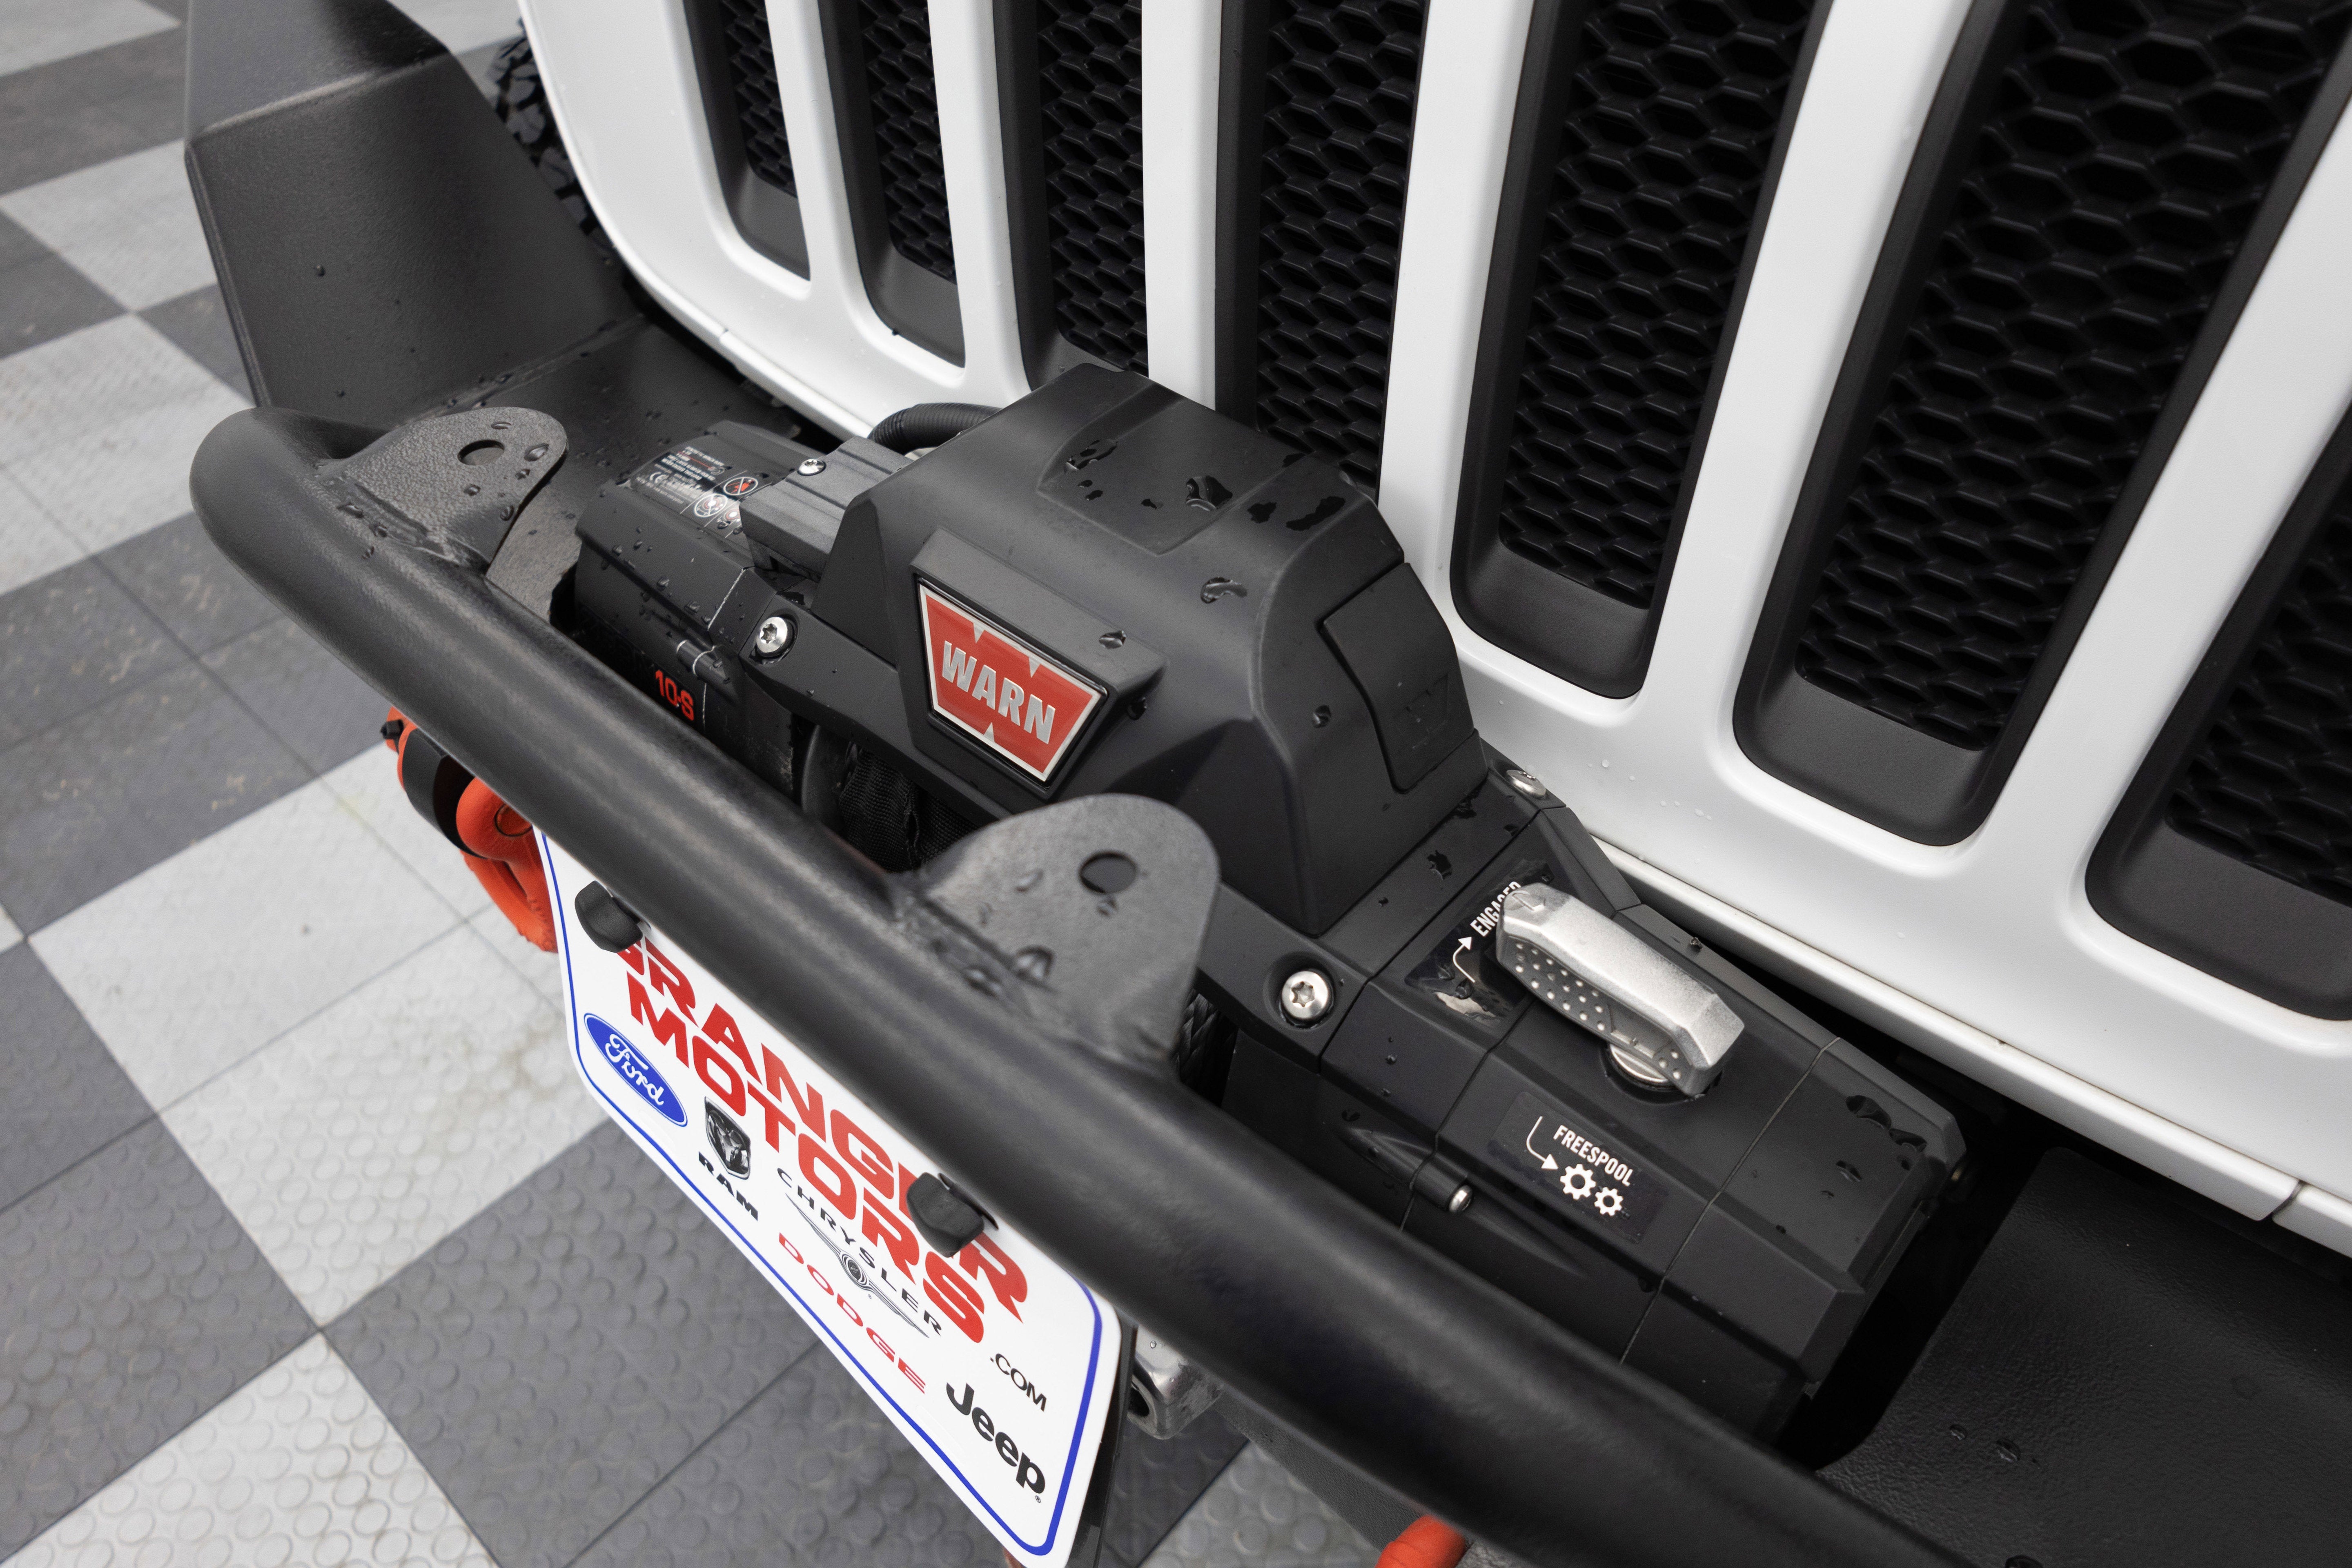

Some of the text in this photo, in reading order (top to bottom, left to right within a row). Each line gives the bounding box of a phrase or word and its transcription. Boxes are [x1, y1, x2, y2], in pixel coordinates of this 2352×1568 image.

[942, 640, 1056, 744] WARN
[605, 1033, 664, 1105] Ford
[626, 970, 985, 1343] MOTORS
[698, 1151, 758, 1221] RAM
[1553, 1125, 1634, 1187] FREESPOOL
[777, 1167, 942, 1336] CHRYSLER
[779, 1232, 926, 1394] DODGE
[990, 1353, 1047, 1412] .COM
[946, 1382, 1046, 1494] Jeep
